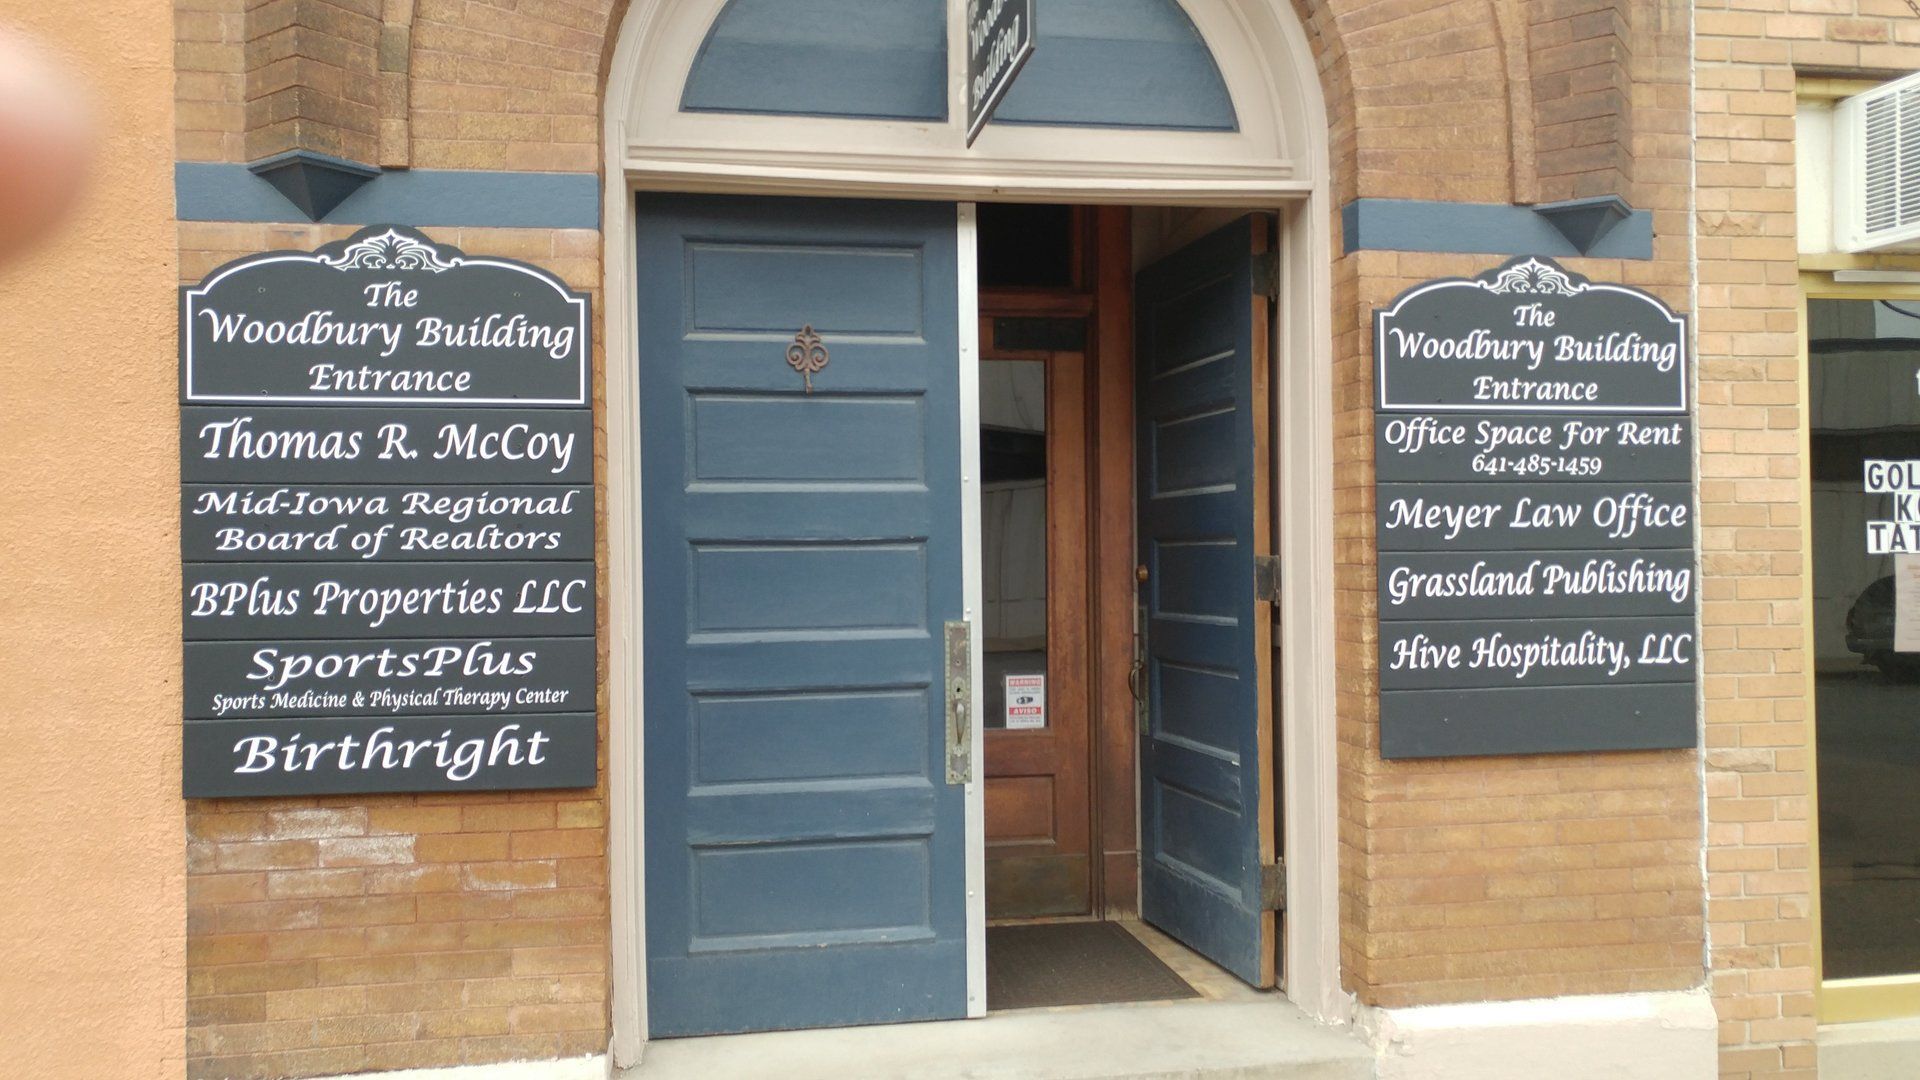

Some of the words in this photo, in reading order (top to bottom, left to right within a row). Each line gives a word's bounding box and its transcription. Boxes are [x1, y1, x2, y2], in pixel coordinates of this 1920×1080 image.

[363, 280, 419, 308] The
[1512, 301, 1556, 328] The
[197, 307, 403, 358] Woodbury
[415, 313, 575, 360] Building
[1388, 327, 1545, 371] Woodbury
[1553, 331, 1677, 373] Building
[308, 363, 471, 392] Entrance
[1472, 375, 1599, 402] Entrance
[198, 416, 363, 460] Thomas
[377, 423, 419, 460] R.
[432, 423, 575, 474] McCoy
[1384, 416, 1466, 454] Office
[1474, 419, 1553, 454] Space
[1558, 420, 1611, 451] For
[1616, 421, 1683, 446] Rent
[1471, 453, 1603, 476] 641-485-1459
[1868, 463, 1920, 490] GOL
[192, 488, 389, 515] Mid-Iowa
[401, 489, 581, 524] Regional
[1385, 498, 1502, 540] Meyer
[1509, 496, 1582, 528] Law
[1592, 492, 1687, 539] Office
[1898, 494, 1920, 521] K
[214, 523, 348, 551] Board
[350, 523, 395, 559] of
[399, 523, 562, 551] Realtors
[1388, 559, 1542, 606] Grassland
[1542, 558, 1691, 604] Publishing
[190, 576, 300, 617] BPlus
[312, 579, 503, 628] Properties
[512, 579, 587, 614] LLC
[245, 640, 537, 691] SportsPlus
[1389, 633, 1461, 670] Hive
[1468, 629, 1631, 679] Hospitality,
[1637, 632, 1693, 665] LLC
[211, 693, 266, 716] Sports
[269, 689, 347, 709] Medicine
[351, 690, 366, 708] &
[369, 688, 439, 713] Physical
[442, 686, 511, 711] Therapy
[515, 687, 570, 705] Center
[232, 723, 550, 782] Birthright
